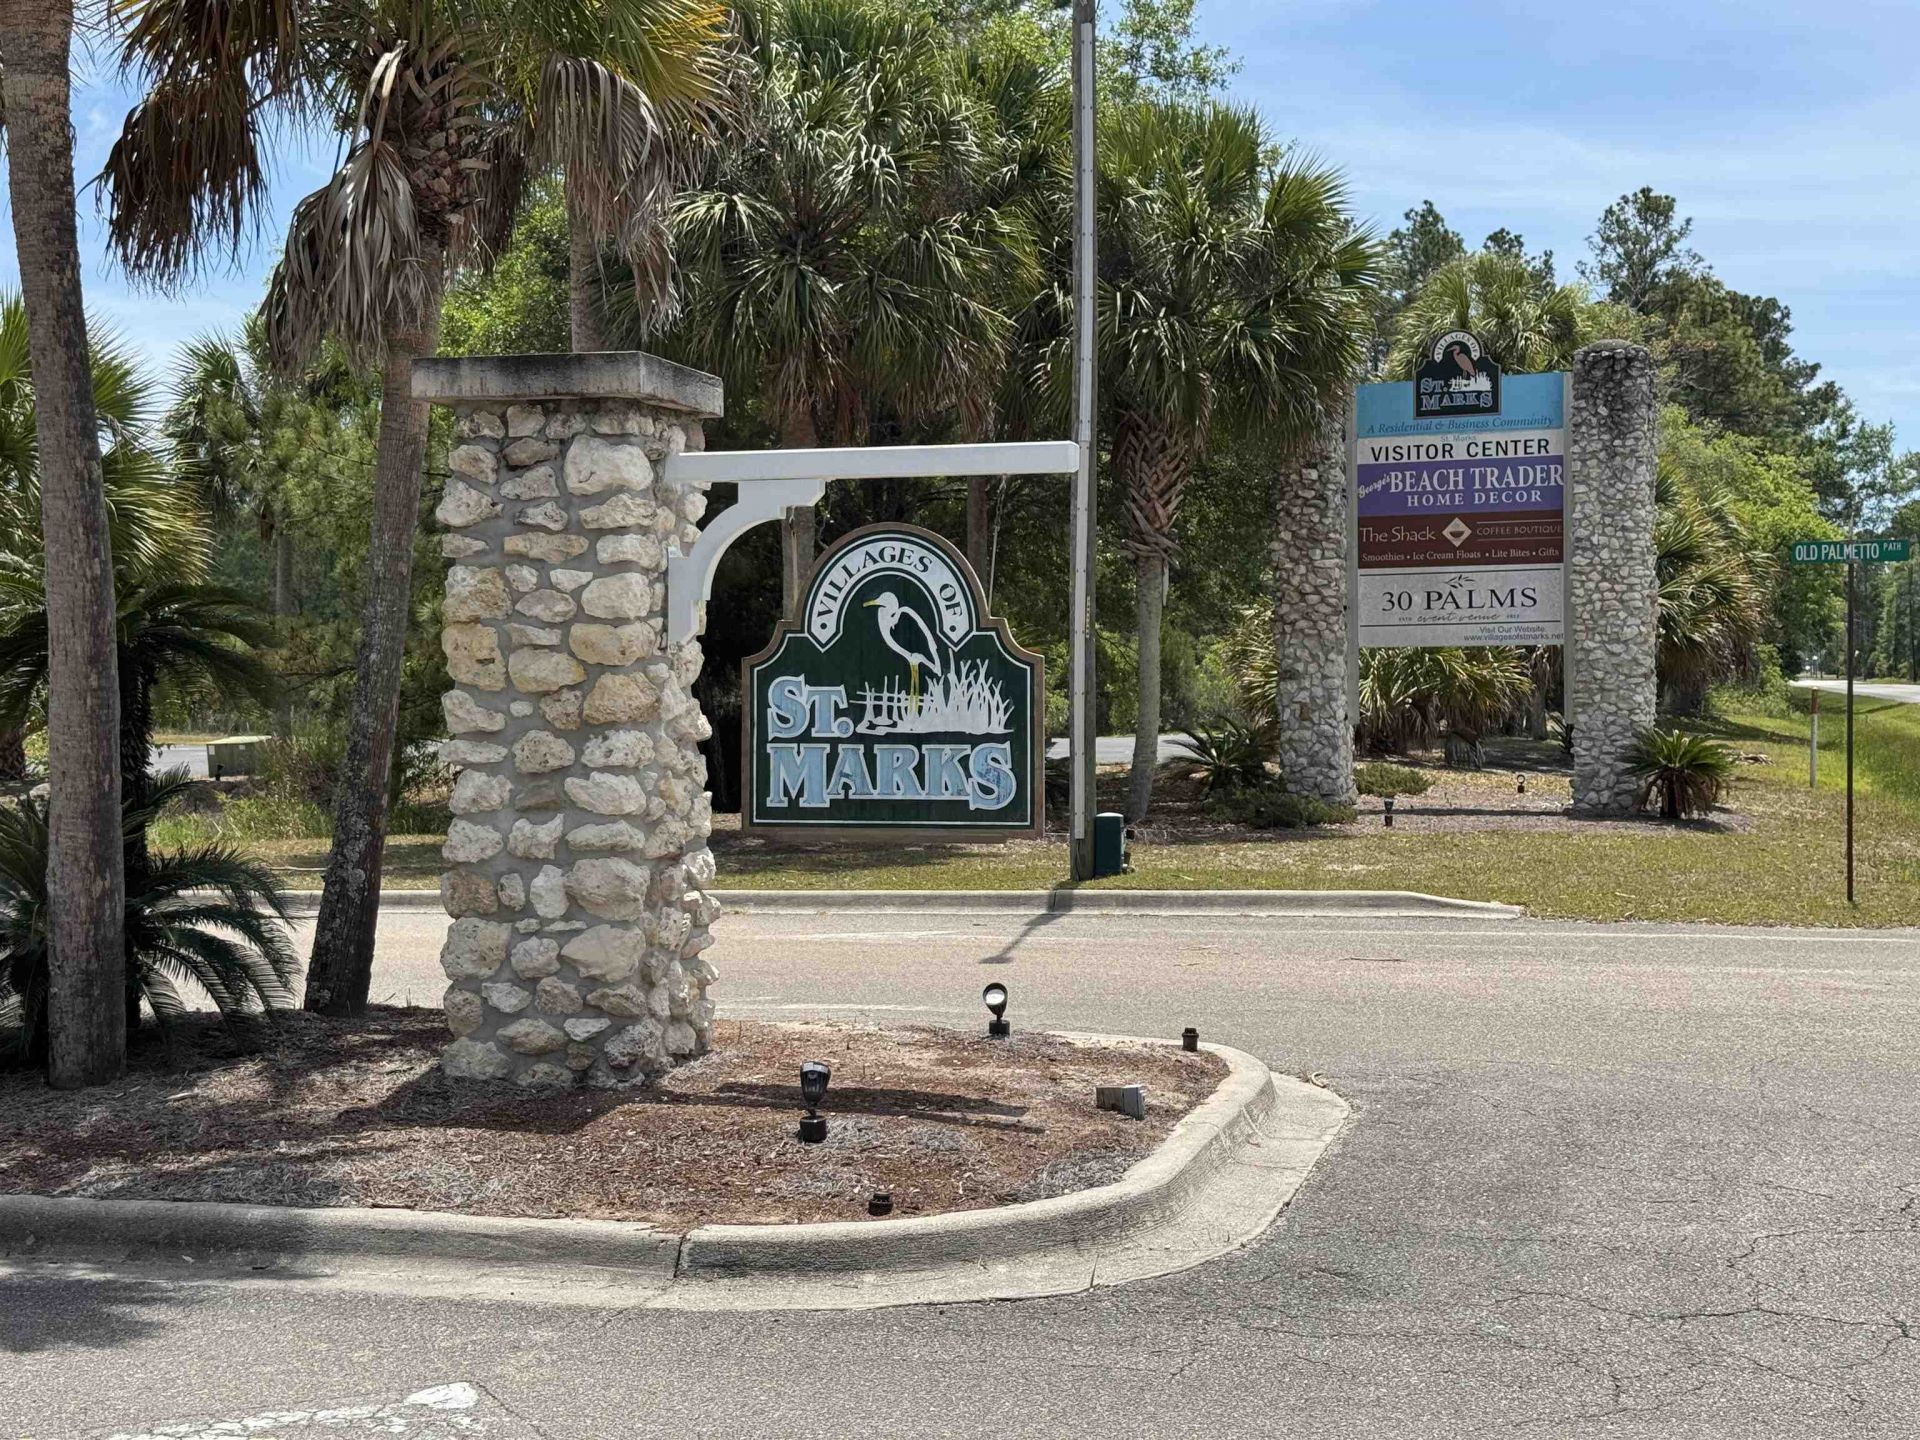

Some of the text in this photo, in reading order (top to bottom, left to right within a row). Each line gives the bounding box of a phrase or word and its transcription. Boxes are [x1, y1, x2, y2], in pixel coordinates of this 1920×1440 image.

[1420, 377, 1449, 394] ST.
[1420, 391, 1493, 411] MARKS
[1367, 415, 1553, 433] A Residential & Business Community
[1370, 438, 1550, 462] VISITOR CENTER
[1389, 468, 1465, 493] BEACH
[1470, 464, 1564, 489] TRADER
[1407, 490, 1542, 507] HOME DECOR
[1360, 525, 1563, 542] The Shack COFFEE BOUTIQUE
[1362, 547, 1560, 561] Smoothies Ice Cream Floats Lite Bites Gifts
[1795, 542, 1901, 561] OLD PALMETTO PATH
[817, 546, 963, 618] VILLAGES OF
[1382, 586, 1538, 612] 30 PALMS
[1480, 626, 1496, 634] Visit
[1497, 625, 1512, 633] Our
[767, 673, 855, 741] ST.
[766, 740, 1018, 811] MARKS
